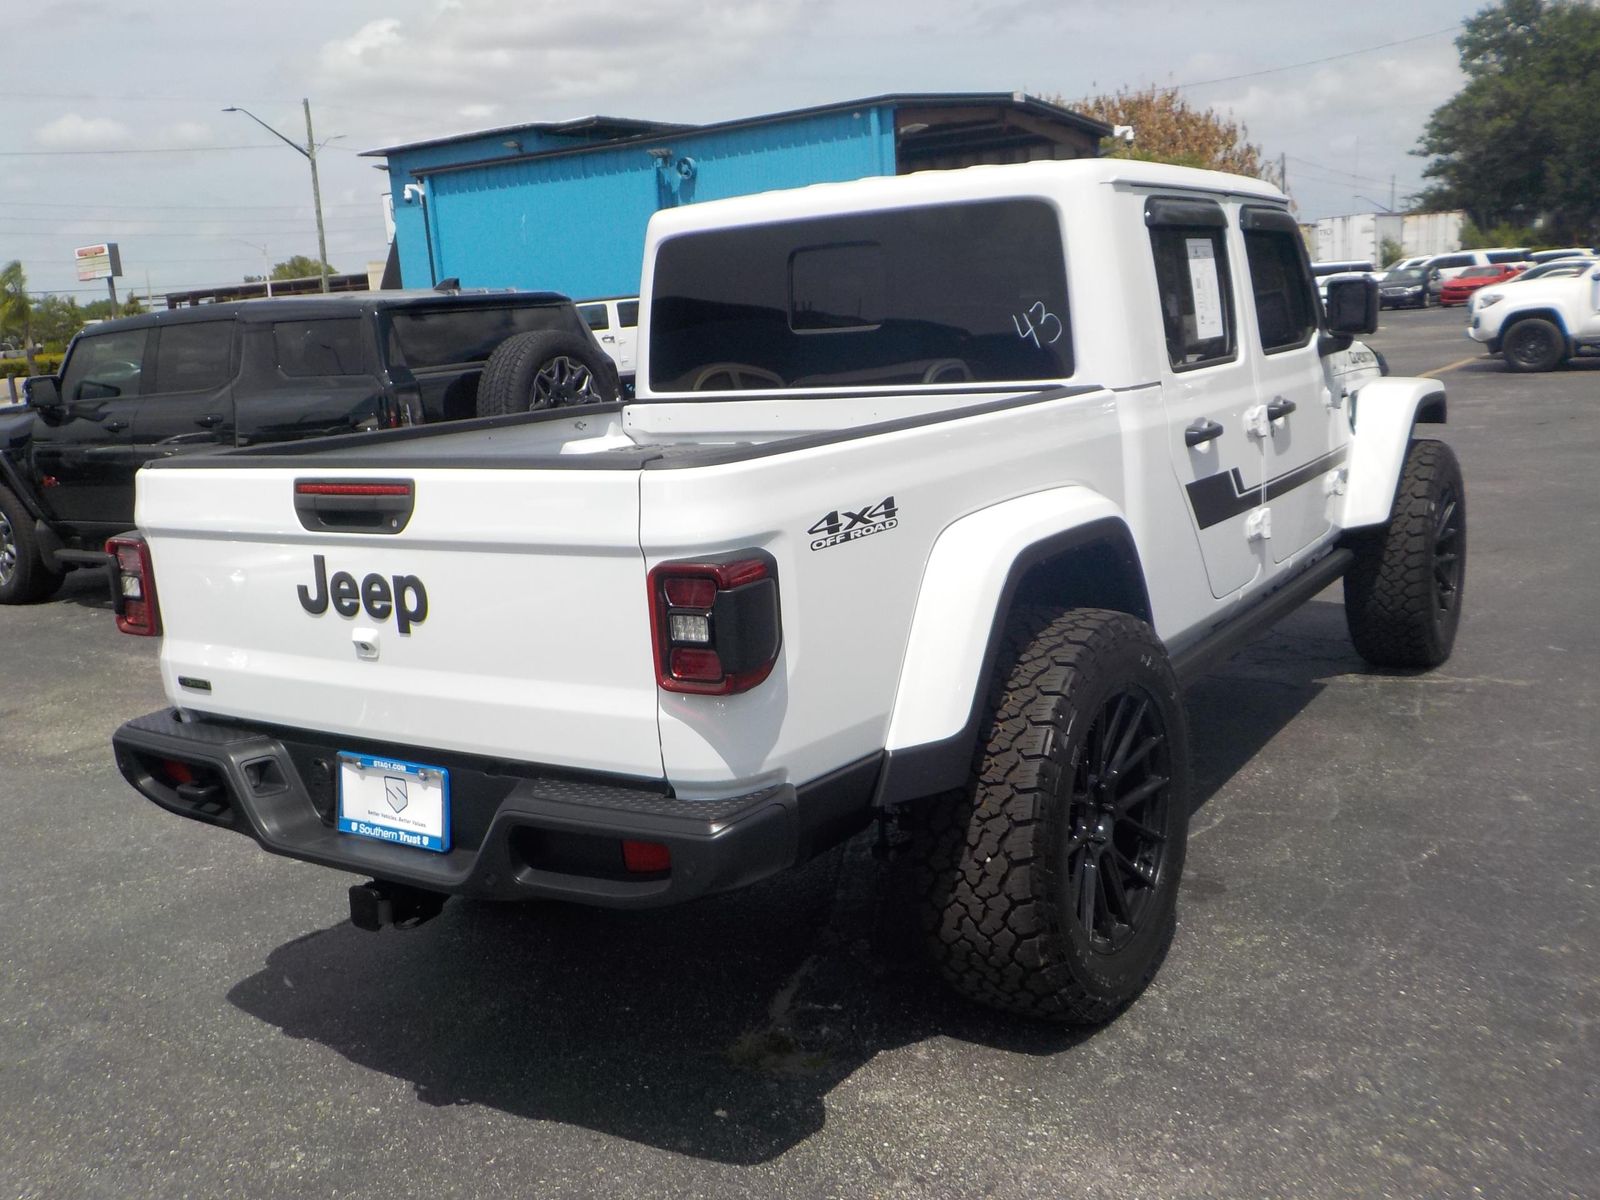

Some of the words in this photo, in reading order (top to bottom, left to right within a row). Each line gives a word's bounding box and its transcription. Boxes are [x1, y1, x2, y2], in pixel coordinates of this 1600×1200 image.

[1012, 301, 1062, 348] 43
[811, 533, 846, 550] OFF
[849, 519, 897, 540] ROAD
[297, 554, 428, 634] Jeep
[359, 823, 398, 841] Southern
[398, 831, 421, 845] Trust
